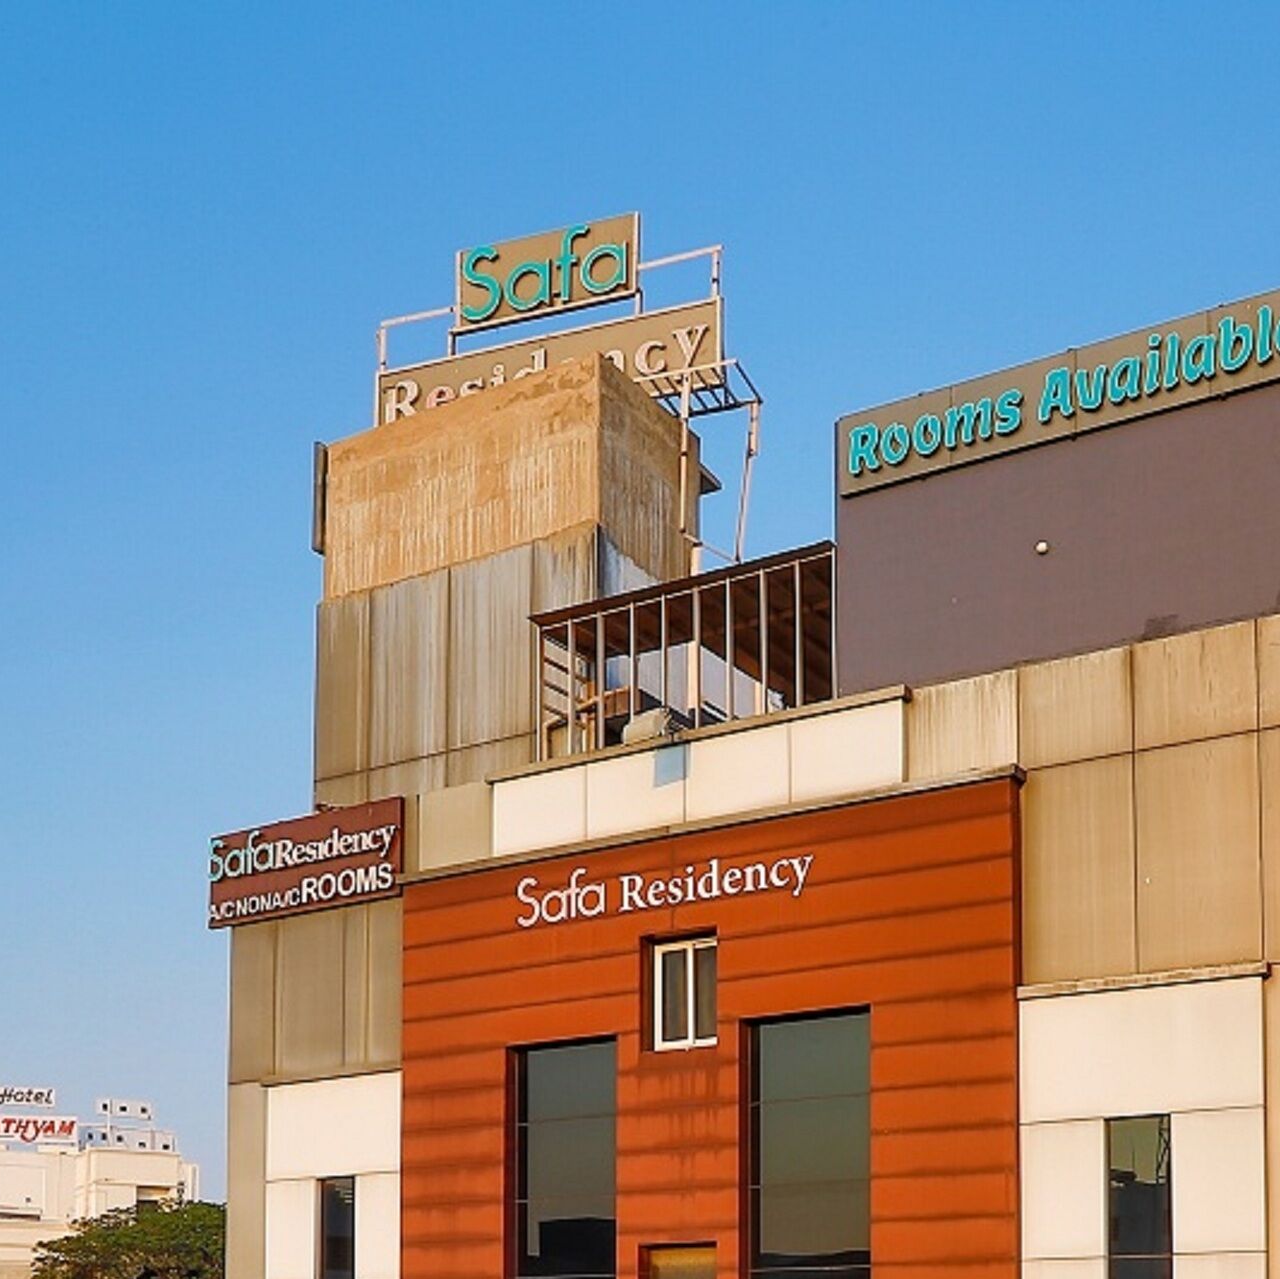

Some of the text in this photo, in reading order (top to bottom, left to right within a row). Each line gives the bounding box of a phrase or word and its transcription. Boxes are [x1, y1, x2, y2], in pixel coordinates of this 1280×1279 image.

[461, 224, 628, 321] Safa
[848, 387, 1023, 475] Rooms
[208, 824, 396, 882] Safa Residency
[301, 863, 394, 904] ROOMS
[516, 854, 815, 928] Safa Residency
